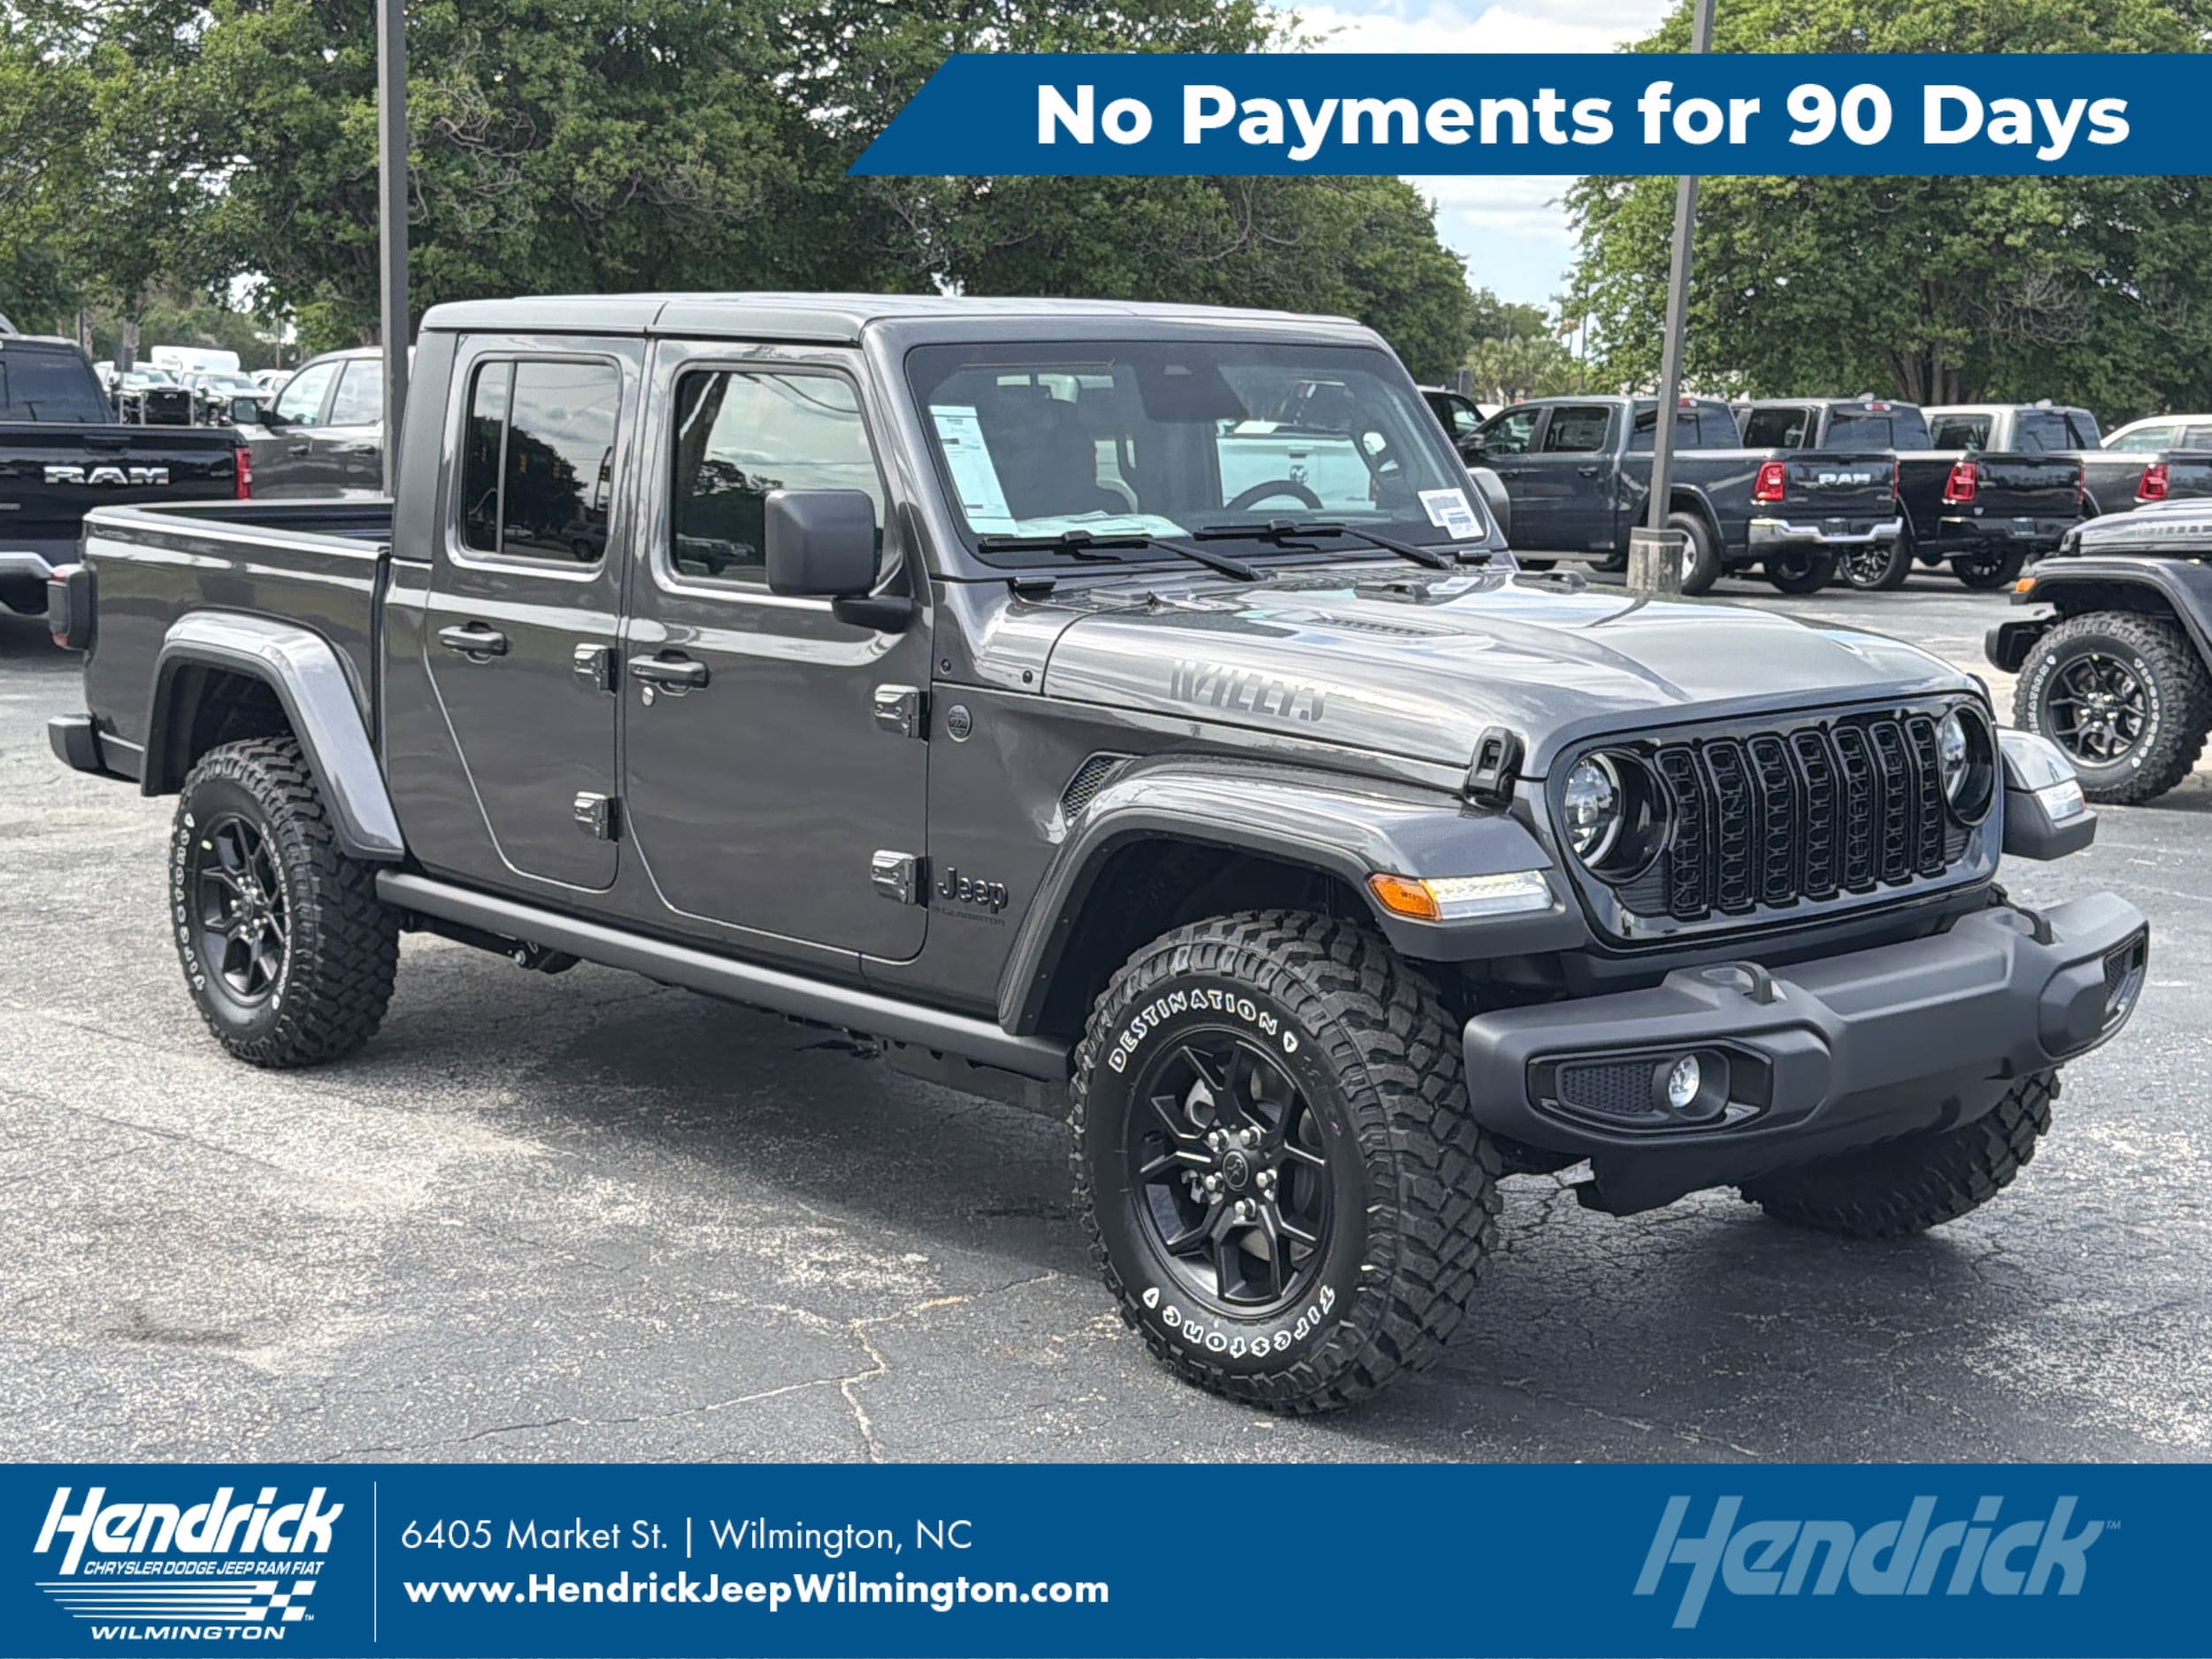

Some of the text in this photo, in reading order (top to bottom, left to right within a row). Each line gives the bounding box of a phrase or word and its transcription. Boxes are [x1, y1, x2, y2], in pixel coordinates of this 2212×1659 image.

[43, 465, 170, 485] RAM
[1817, 473, 1871, 485] RAM
[937, 866, 1008, 914] Jeep
[1109, 988, 1278, 1073] DESTINATION
